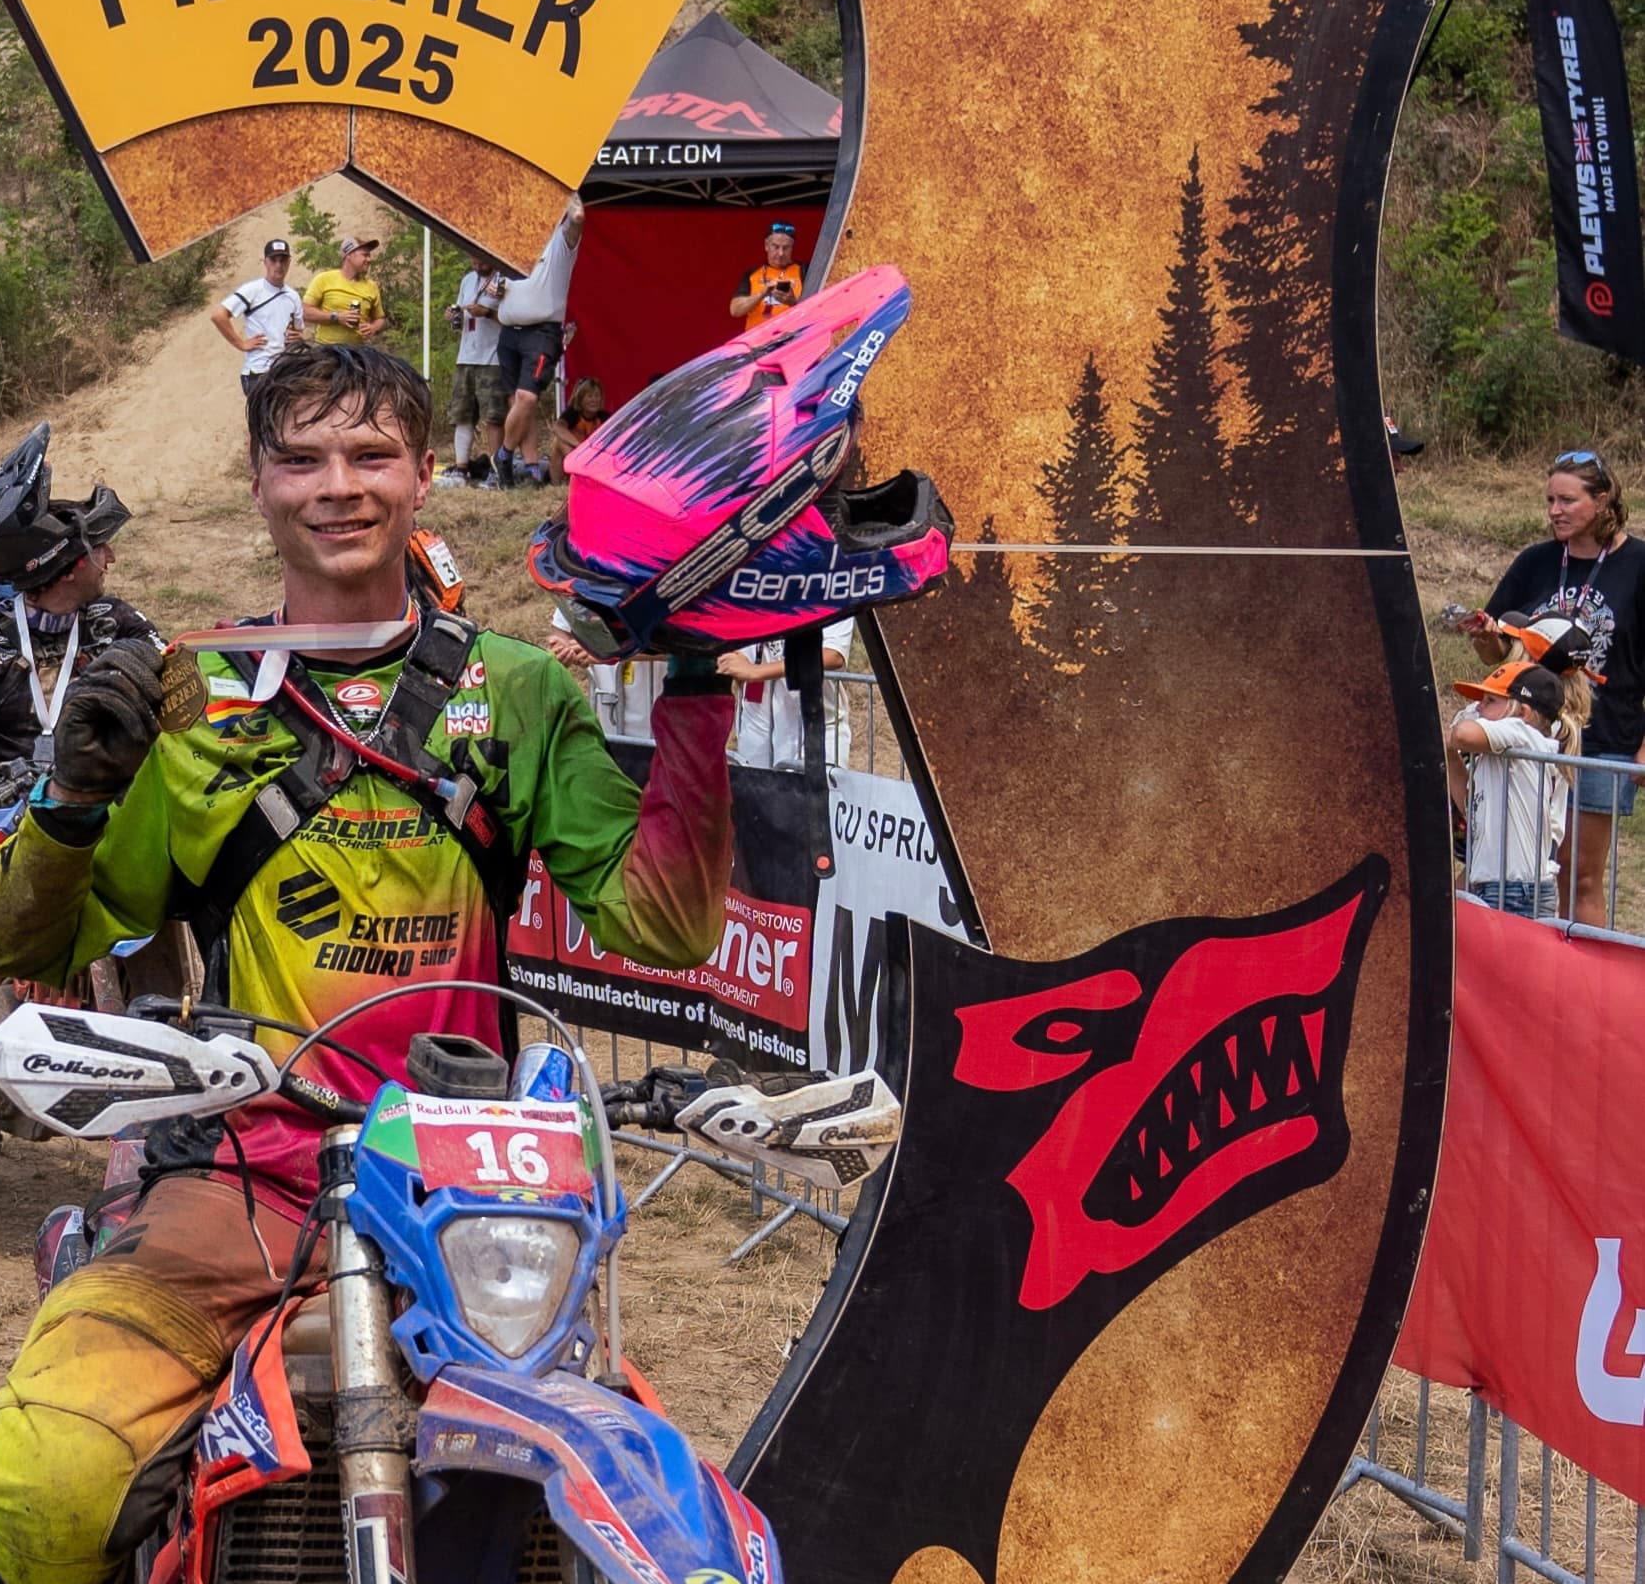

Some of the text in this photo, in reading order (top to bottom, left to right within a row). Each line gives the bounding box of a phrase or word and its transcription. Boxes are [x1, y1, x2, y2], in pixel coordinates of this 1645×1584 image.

[248, 18, 458, 105] 2025
[591, 144, 722, 166] EATT.COM
[1556, 16, 1605, 276] PLEWS TYRES
[1592, 96, 1616, 212] MADE TO WIN!
[729, 545, 885, 601] Gerriets
[446, 703, 489, 718] LIQUI
[446, 717, 491, 735] MOLY
[834, 800, 862, 844] CU
[348, 911, 460, 944] EXTREME
[752, 909, 803, 934] PISTONS
[314, 942, 457, 977] ENDURO SHOP
[507, 961, 556, 992] stons
[687, 967, 697, 984] &
[700, 970, 760, 1010] DEVELOPMENT
[558, 973, 807, 1066] Manufacturer of forged pistons
[23, 1053, 145, 1081] Polisport
[416, 1102, 443, 1116] Red
[445, 1103, 472, 1116] Bull
[466, 1130, 550, 1185] 16
[234, 1391, 273, 1445] Beta
